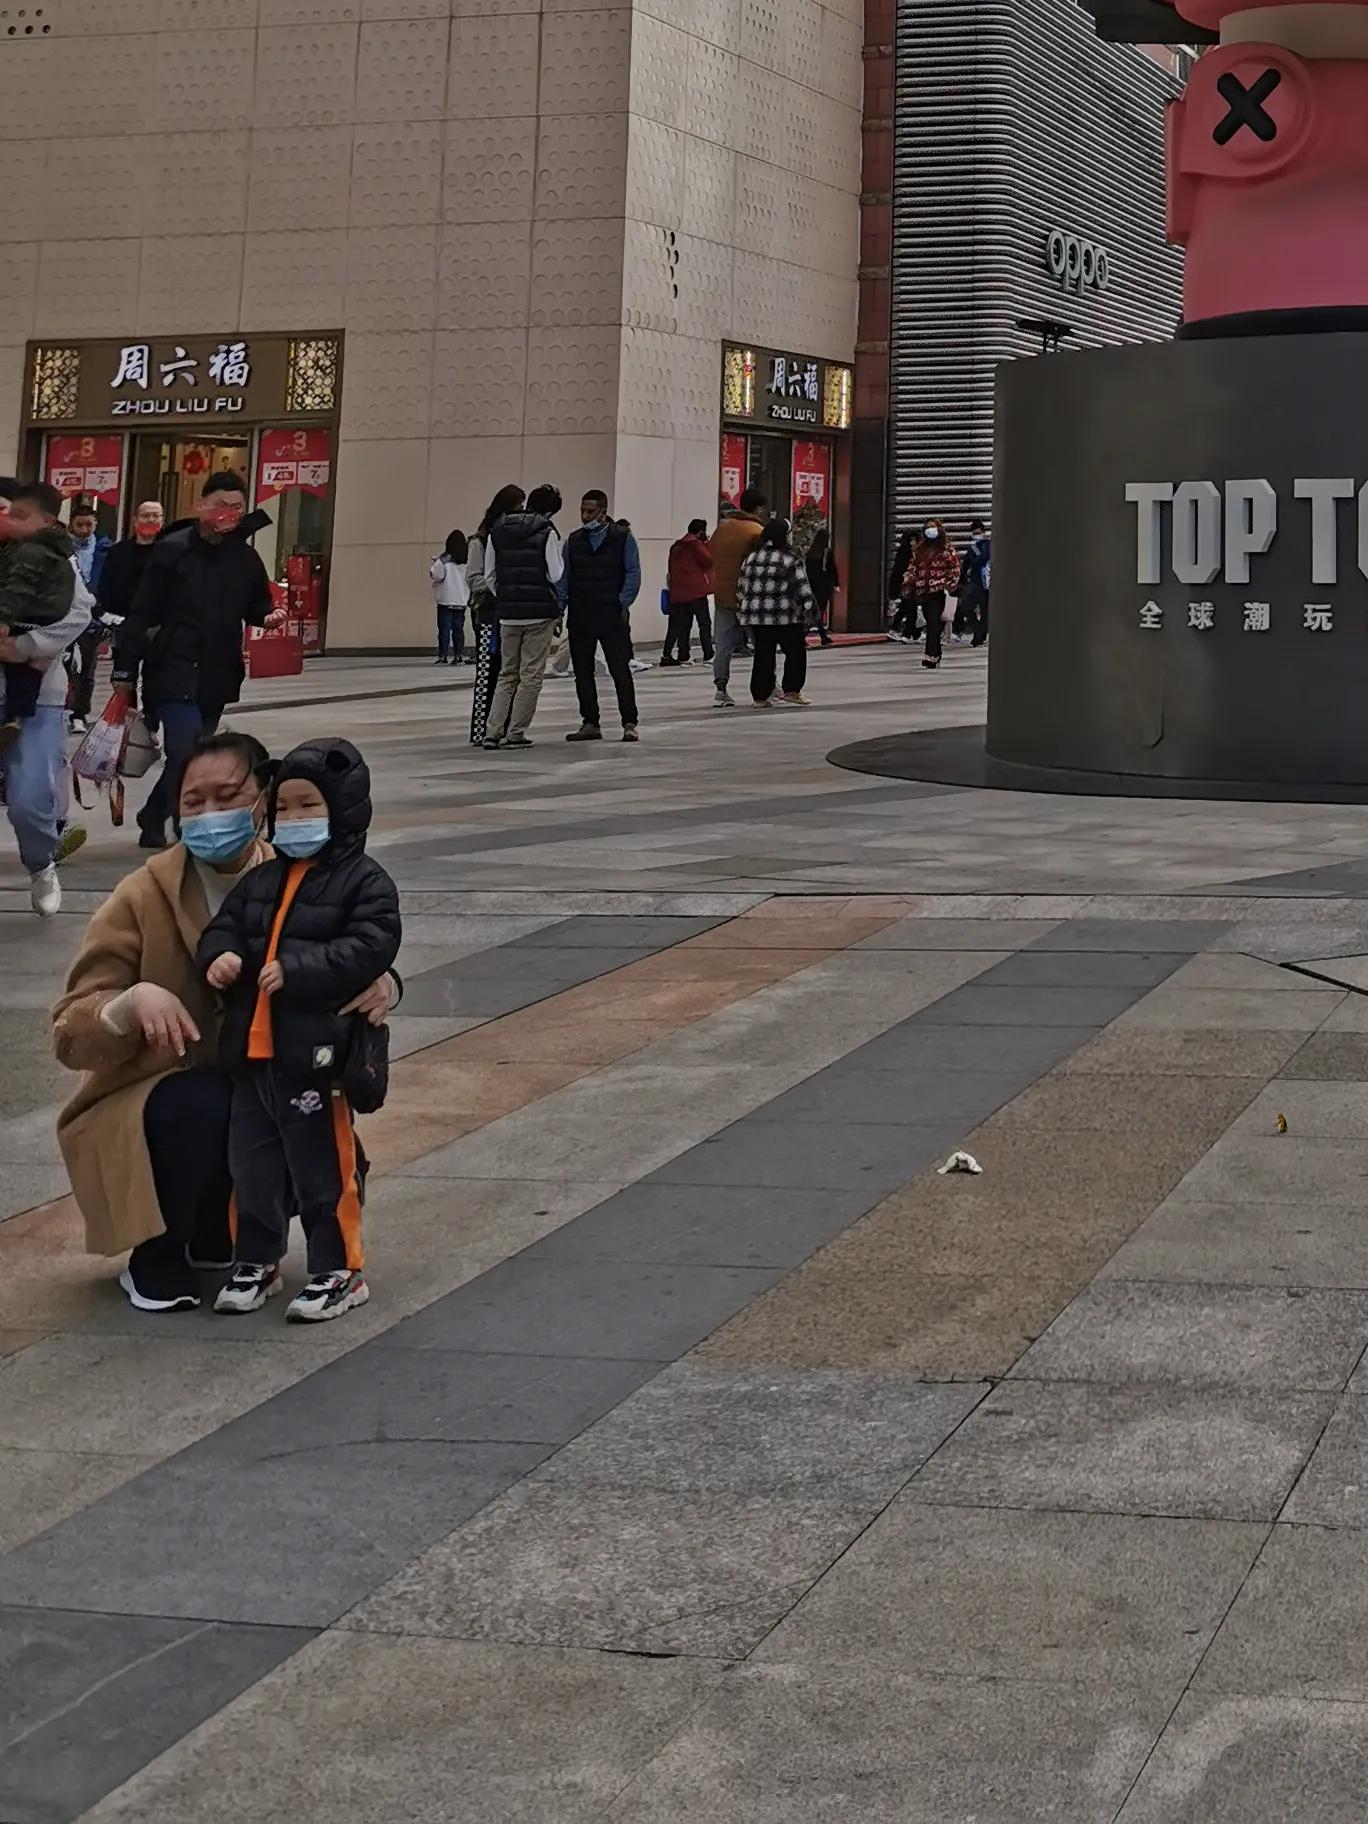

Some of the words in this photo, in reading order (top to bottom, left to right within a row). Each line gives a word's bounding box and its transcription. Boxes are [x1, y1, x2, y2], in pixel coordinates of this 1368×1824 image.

[110, 342, 250, 390] 周六福
[770, 356, 819, 402] 周六福
[111, 399, 170, 415] ZHOU
[175, 397, 208, 413] LIU
[214, 396, 244, 412] FU
[771, 404, 792, 420] ZHOU
[806, 409, 817, 423] FU
[1125, 478, 1277, 584] TOP
